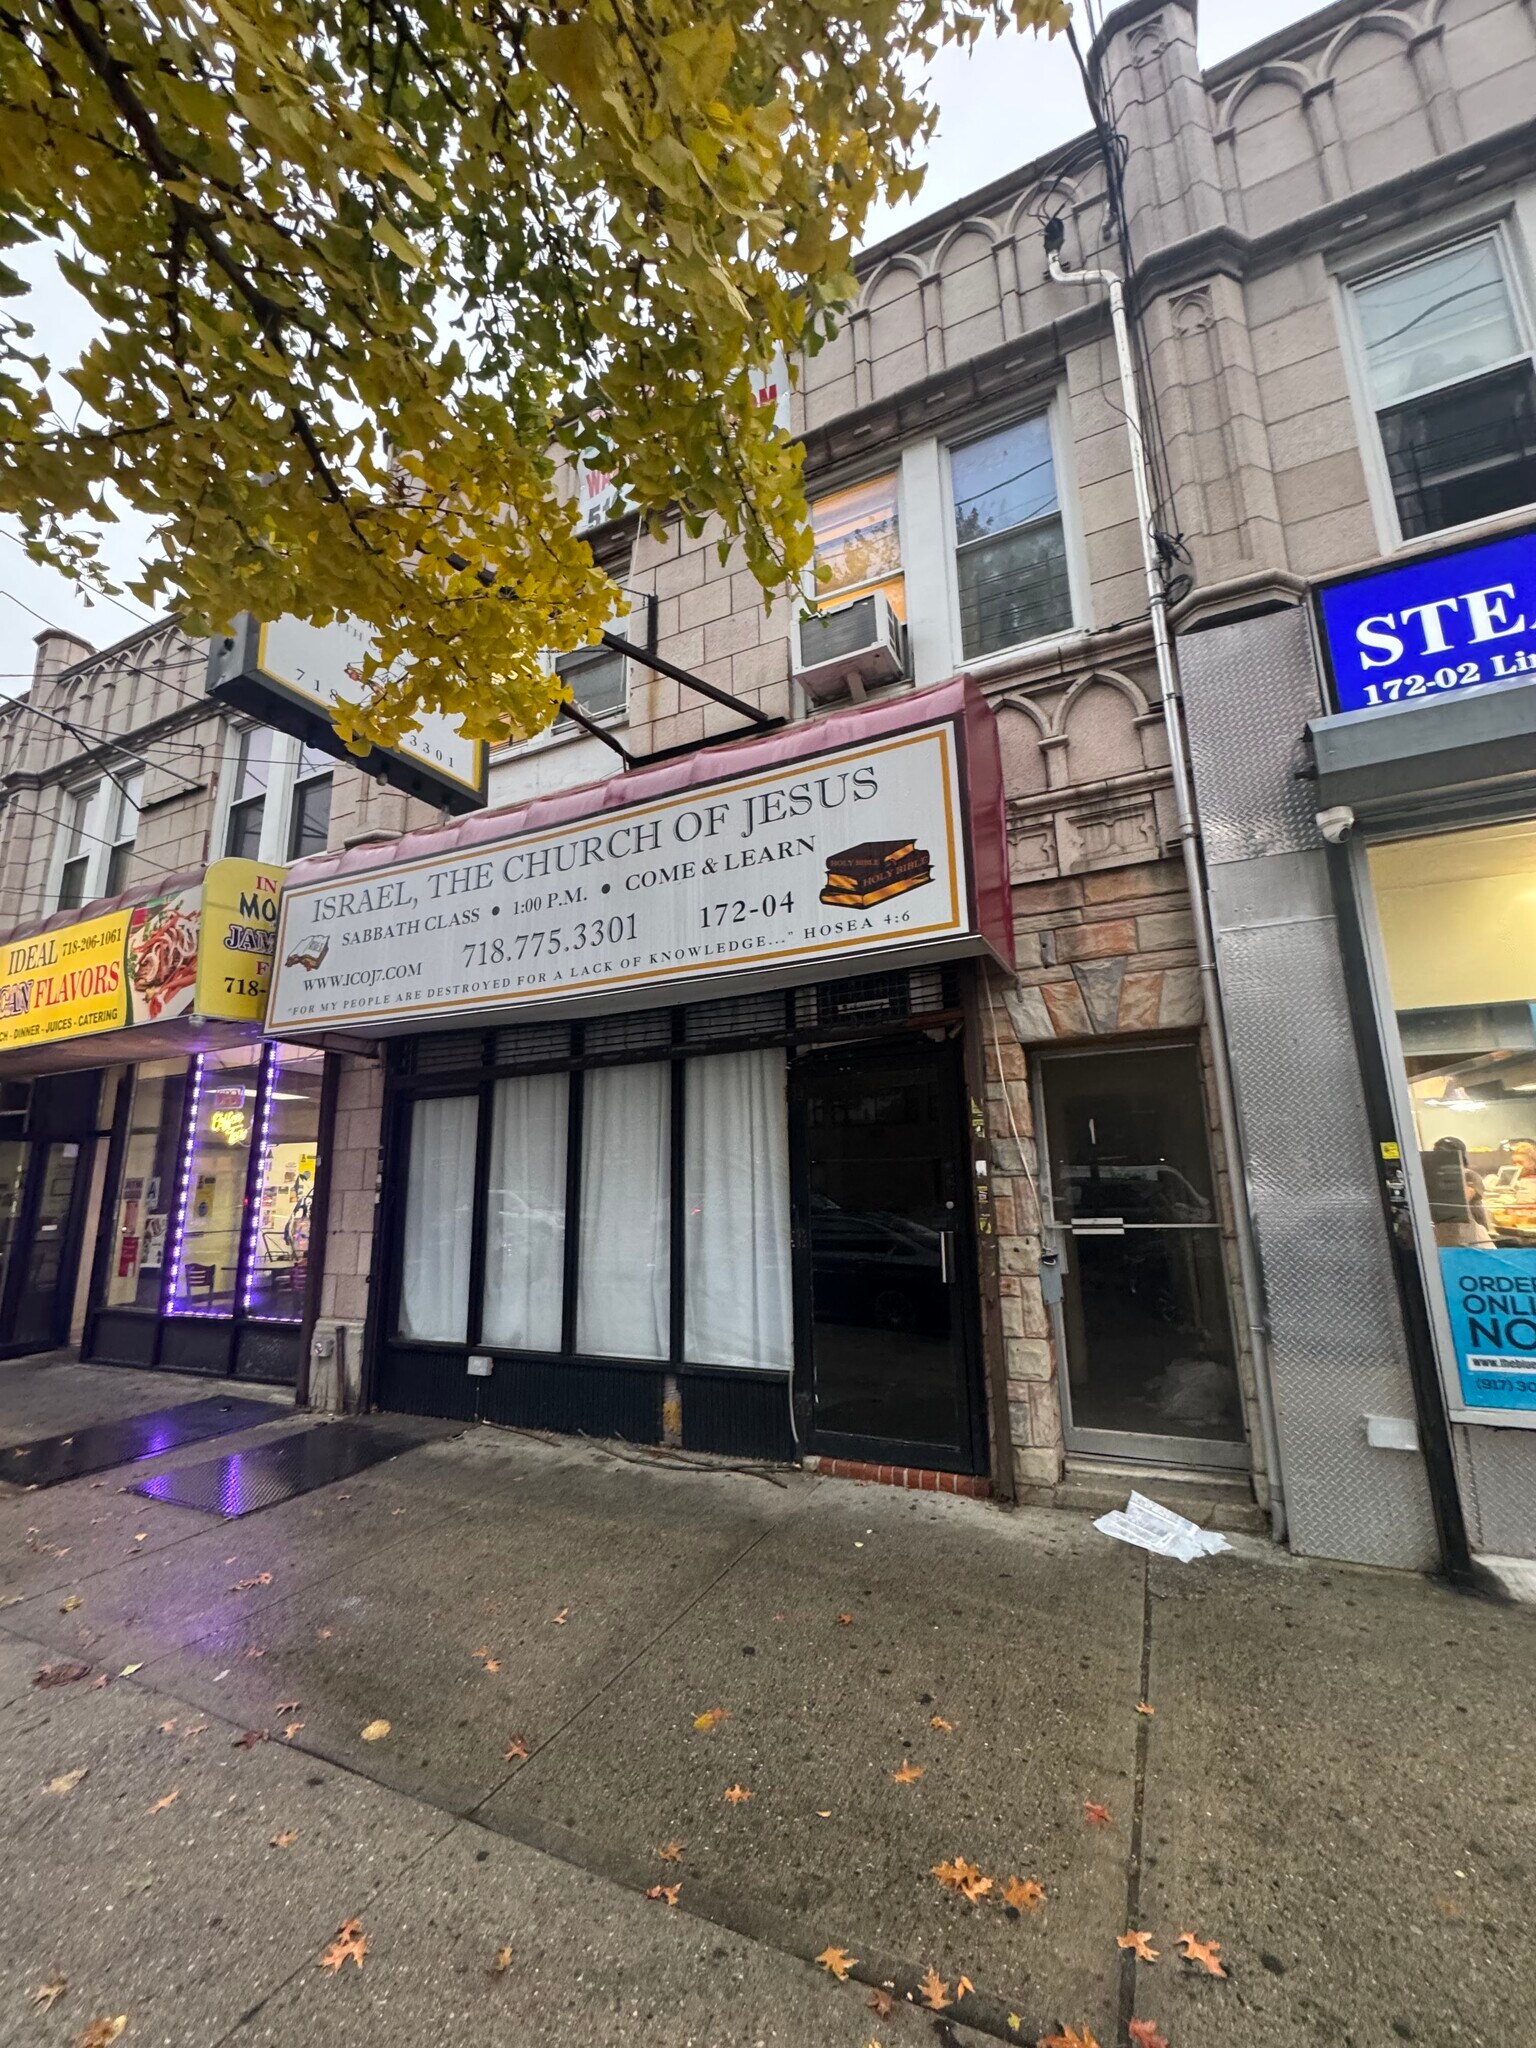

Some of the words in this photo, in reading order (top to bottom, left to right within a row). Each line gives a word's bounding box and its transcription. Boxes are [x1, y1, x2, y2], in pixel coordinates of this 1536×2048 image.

[1355, 583, 1536, 670] STE
[1363, 662, 1480, 706] 172-02
[311, 881, 418, 923] ISRAEL,
[428, 862, 494, 899] THE
[503, 820, 662, 883] CHURCH
[673, 803, 730, 842] OF
[741, 766, 878, 838] JESUS
[256, 875, 278, 894] IN
[341, 919, 420, 946] SABBATH
[424, 908, 480, 931] CLASS
[513, 896, 542, 916] 1:00
[547, 886, 588, 908] P.M.
[625, 861, 696, 891] COME
[701, 857, 719, 875] &
[725, 835, 816, 870] LEARN
[863, 868, 895, 888] HOLY
[896, 854, 929, 875] BIBLE
[8, 939, 58, 976] IDEAL
[62, 927, 122, 958] 718-206-1061
[463, 912, 638, 968] 718.775.3301
[701, 891, 794, 928] 172-04
[34, 961, 120, 1008] FLAVORS
[321, 1001, 339, 1012] MY
[343, 994, 390, 1009] PEOPLE
[395, 990, 422, 1002] ARE
[427, 978, 511, 998] DESTROYED
[517, 972, 546, 986] FOR
[553, 970, 563, 981] A
[571, 961, 613, 977] LACK
[620, 956, 641, 969] OF
[804, 917, 874, 939] HOSEA
[884, 910, 910, 925] 4:6
[14, 1024, 40, 1039] DINNER
[45, 1017, 72, 1034] JUICES
[78, 1008, 118, 1026] CATERING
[1459, 1275, 1536, 1293] ORDE
[1468, 1317, 1536, 1350] NO
